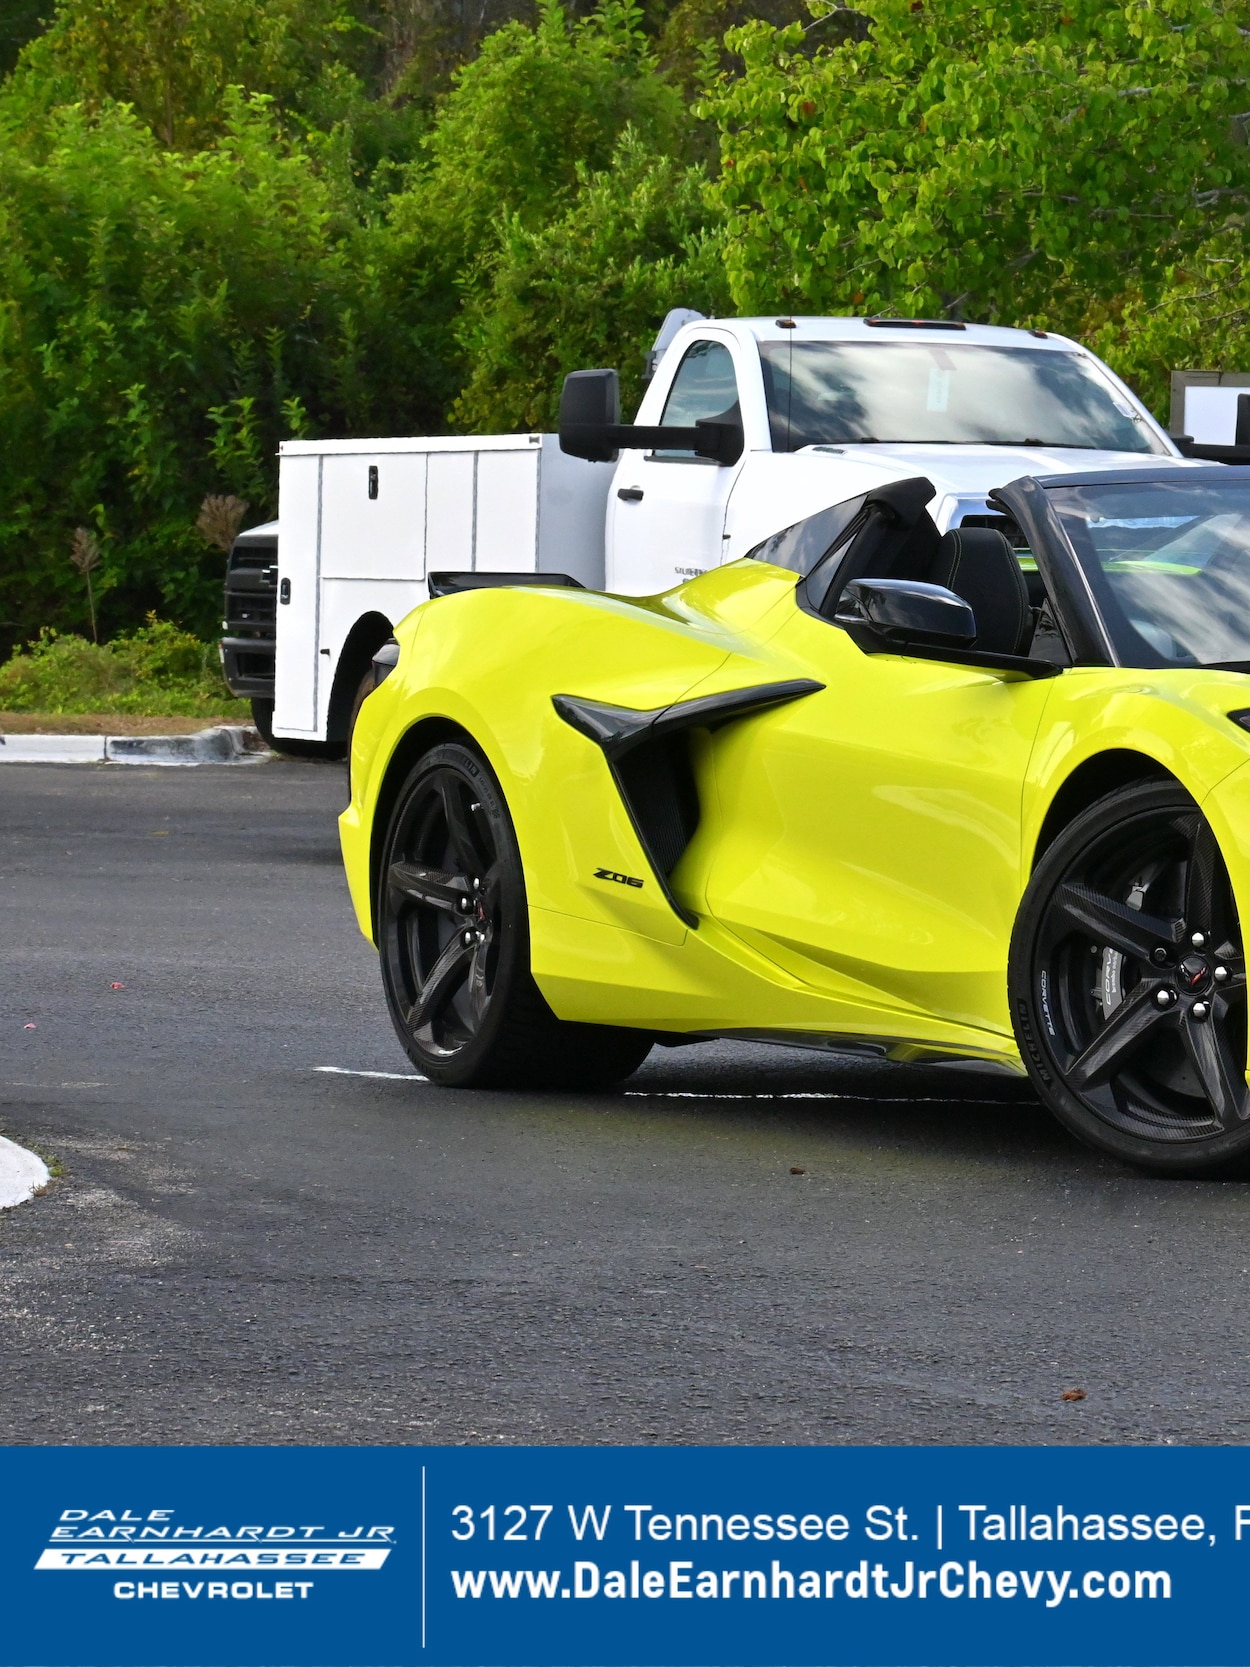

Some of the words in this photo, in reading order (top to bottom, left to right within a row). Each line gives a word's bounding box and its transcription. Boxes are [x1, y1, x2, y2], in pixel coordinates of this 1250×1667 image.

[593, 867, 644, 889] Z06
[1041, 970, 1055, 1036] CORVETTE
[1020, 1001, 1051, 1081] MICHELIN
